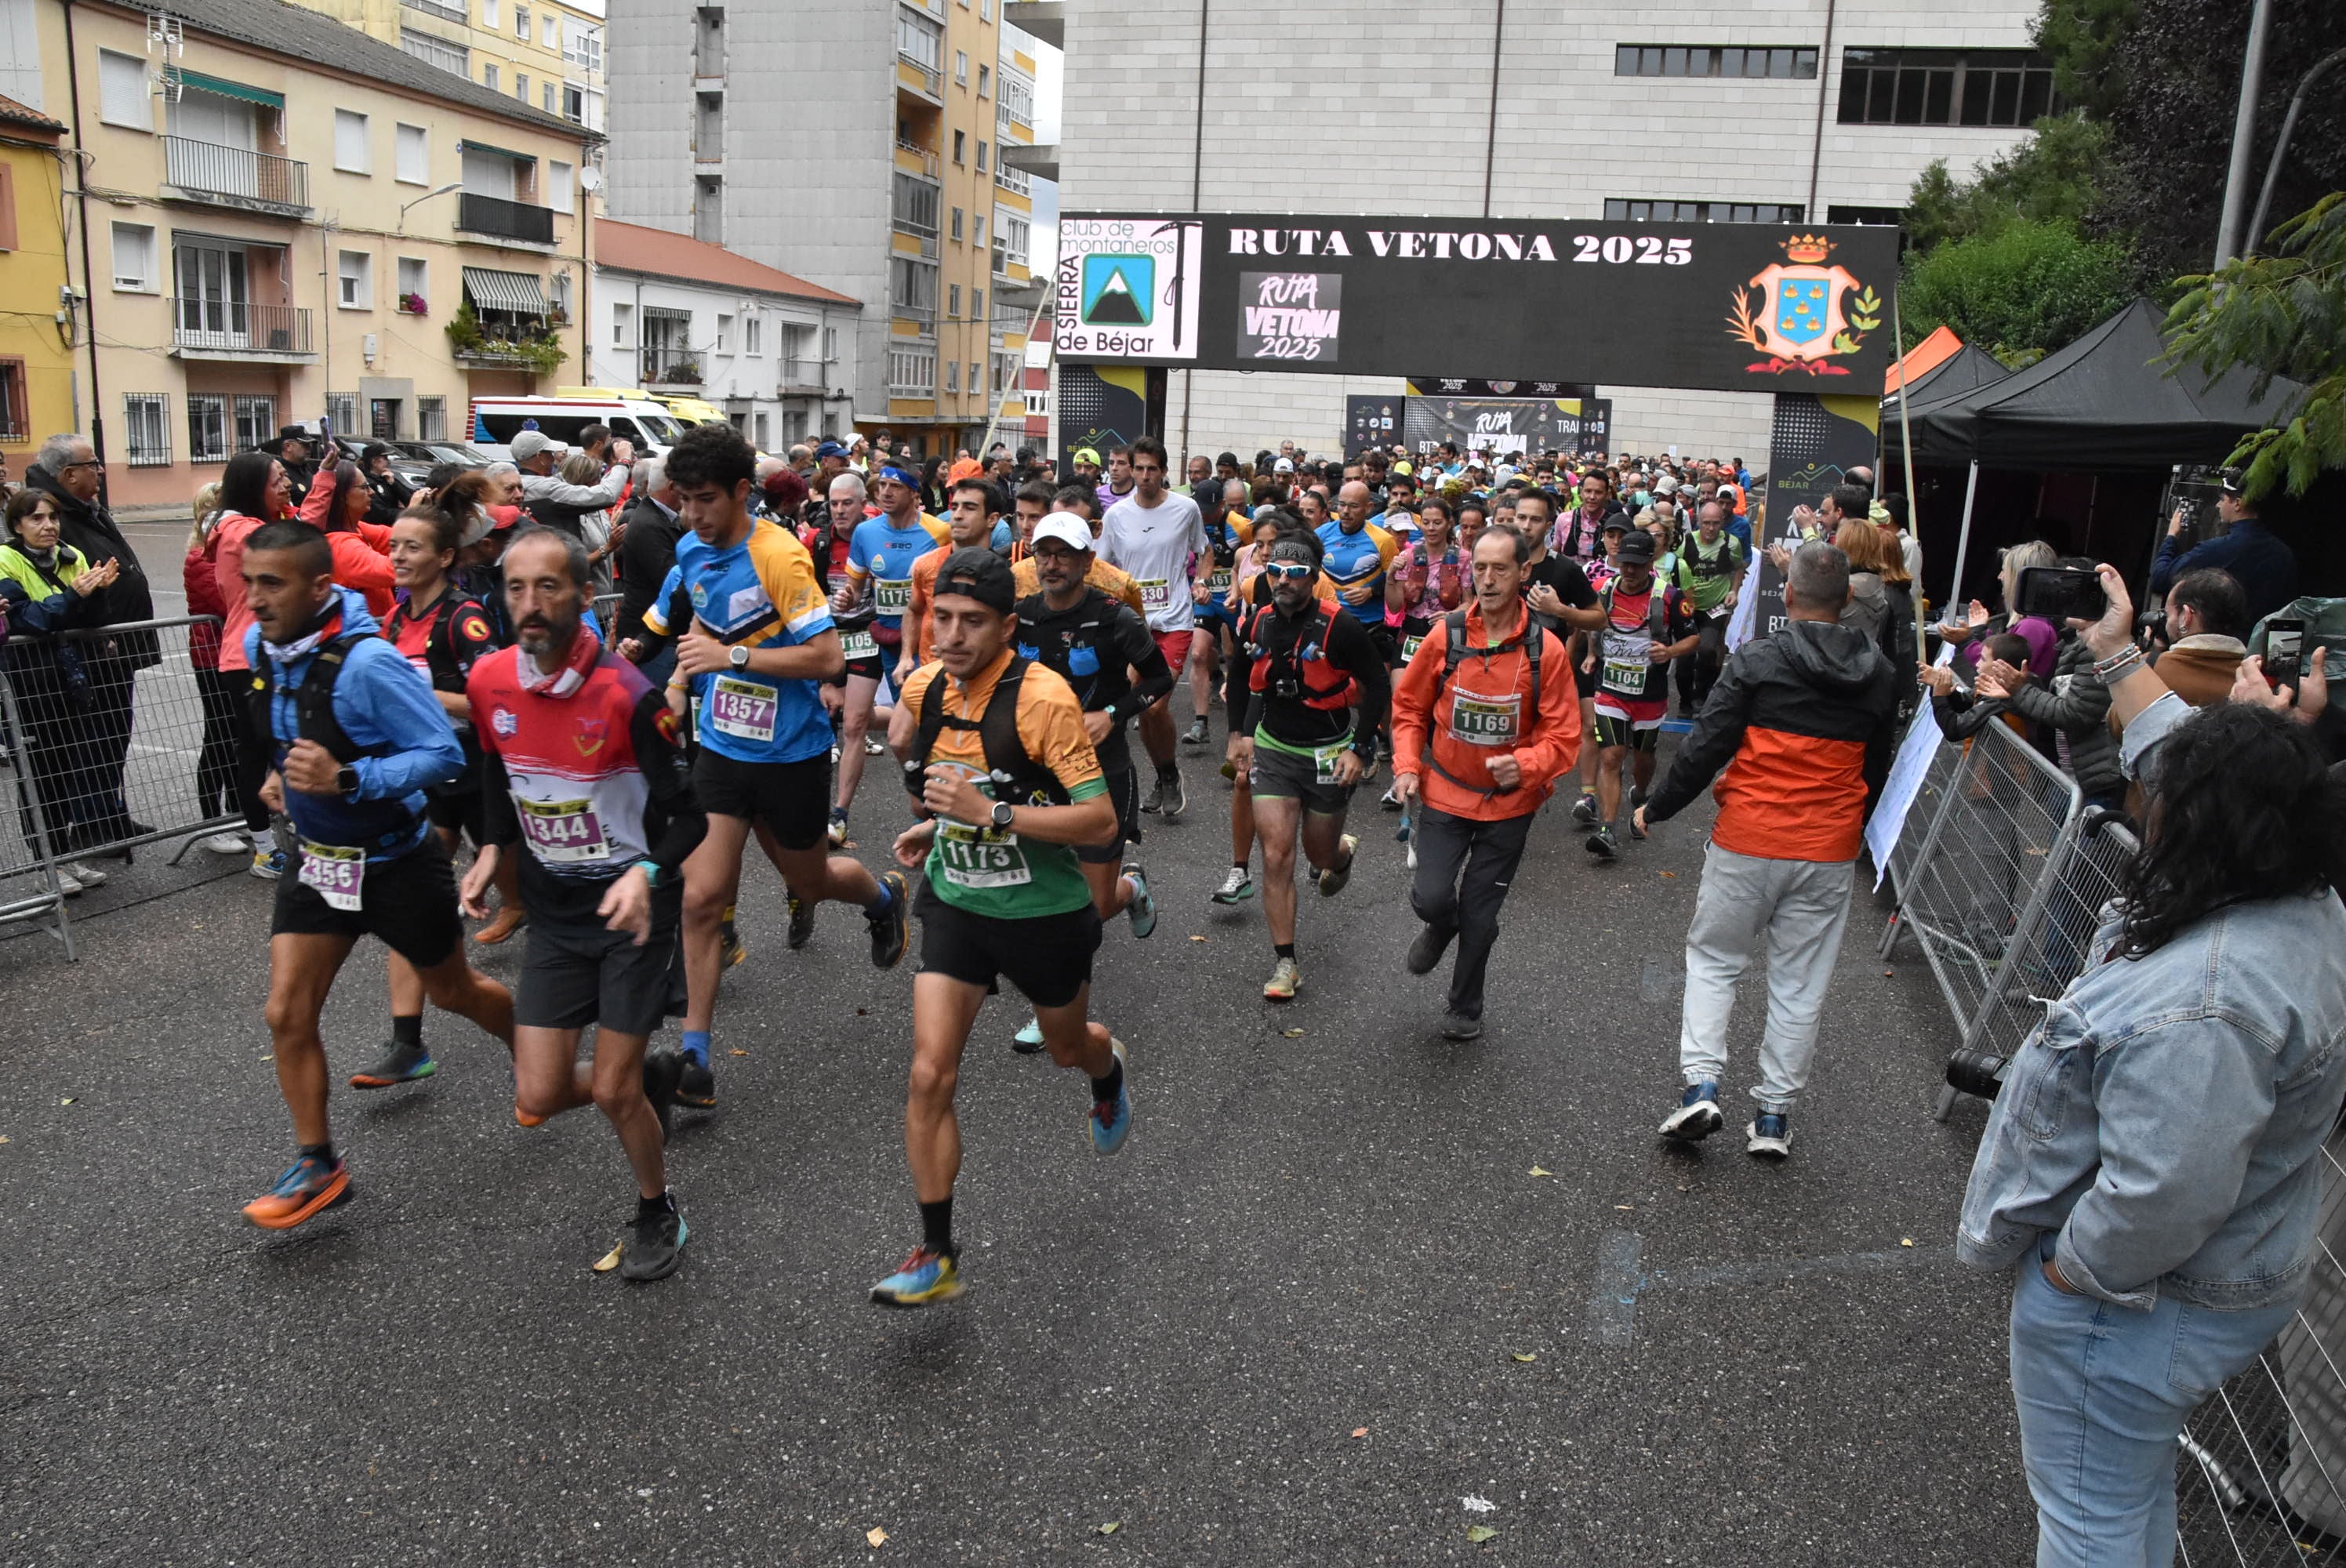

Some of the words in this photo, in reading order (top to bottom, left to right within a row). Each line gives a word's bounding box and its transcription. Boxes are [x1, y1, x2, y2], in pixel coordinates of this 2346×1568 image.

[1061, 220, 1102, 236] club
[1108, 220, 1135, 237] de
[1060, 235, 1175, 254] montañeros
[1228, 228, 1353, 257] RUTA
[1366, 231, 1559, 262] VETONA
[1572, 235, 1692, 265] 2025
[1058, 255, 1080, 329] SIERRA
[1258, 274, 1318, 308] RUTA
[1245, 306, 1341, 339] VETONA
[1057, 331, 1088, 351] de
[1096, 330, 1154, 357] Béjar
[1254, 337, 1321, 361] 2025
[1476, 411, 1513, 434] RUTA
[1556, 419, 1579, 434] TRAI
[1211, 575, 1229, 586] 161
[881, 589, 912, 604] 1175
[1141, 587, 1164, 601] 330
[841, 633, 872, 650] 1105
[1610, 669, 1640, 685] 1104
[719, 692, 768, 721] 1357
[1462, 711, 1510, 731] 1169
[525, 814, 590, 842] 1344
[946, 840, 1011, 869] 1173
